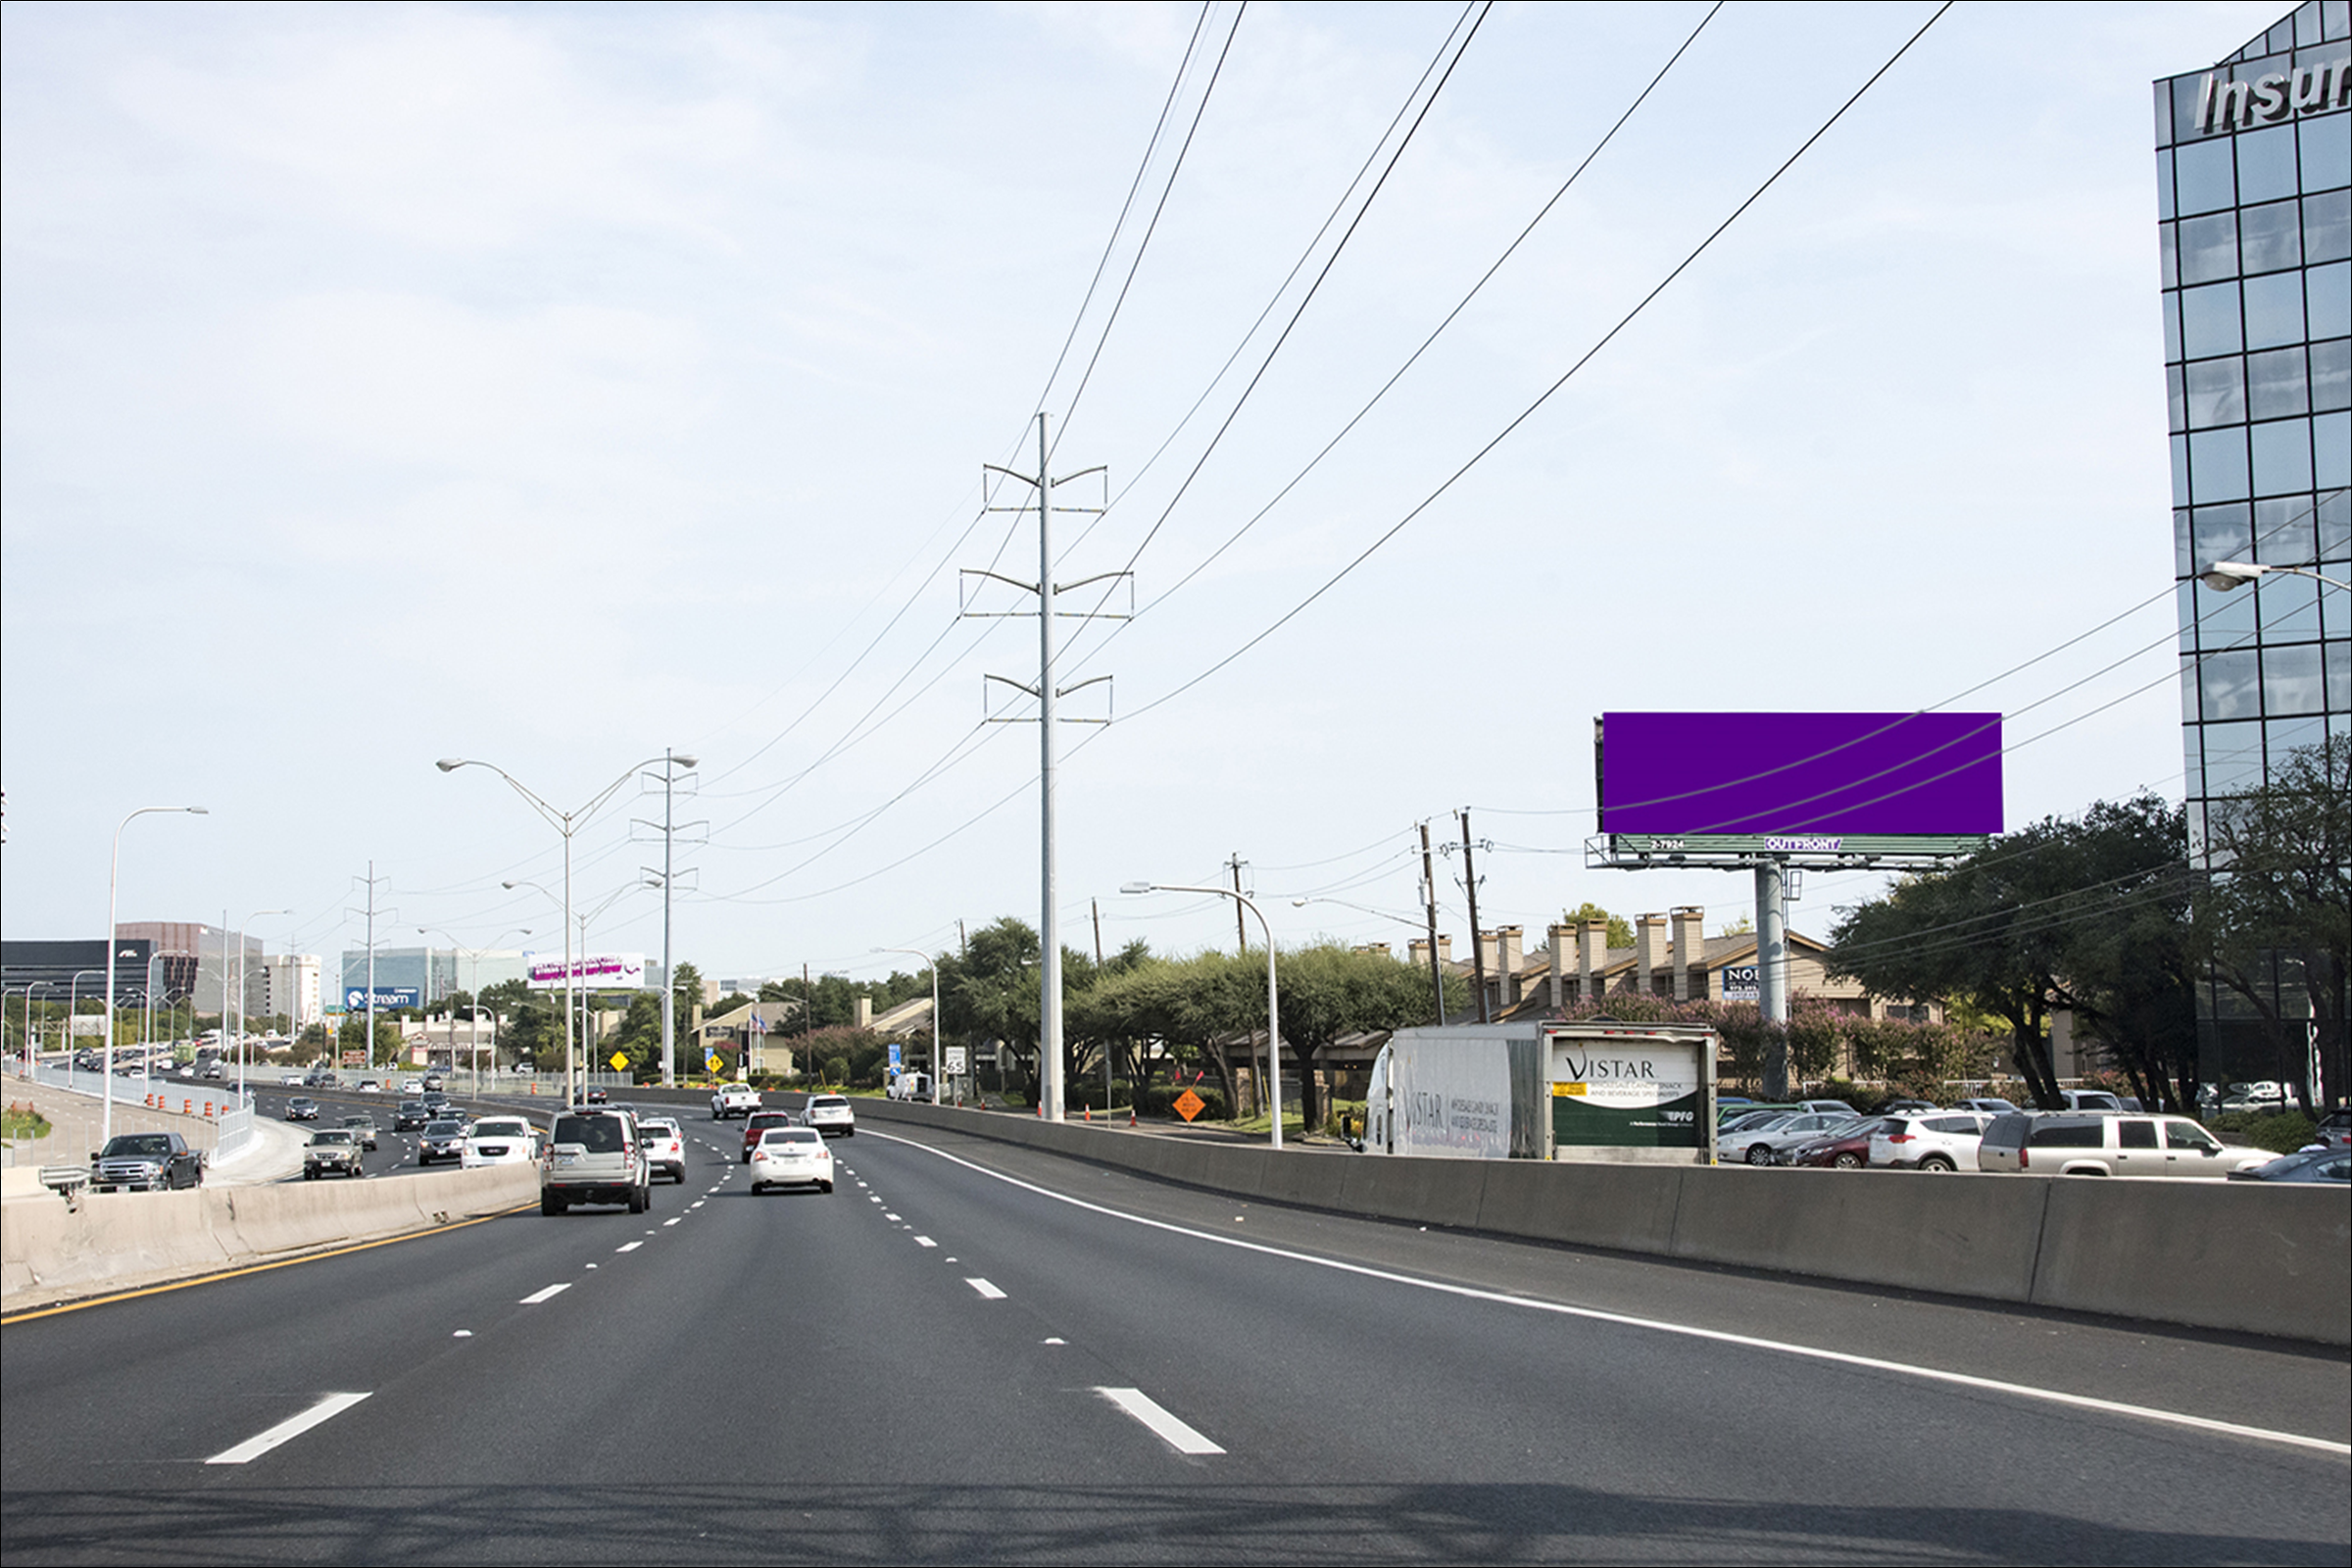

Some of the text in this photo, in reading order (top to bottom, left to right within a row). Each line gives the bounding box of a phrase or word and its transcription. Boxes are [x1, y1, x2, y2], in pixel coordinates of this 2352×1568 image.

[2194, 56, 2351, 130] Insur
[1766, 837, 1838, 850] OUTFRONT
[947, 1061, 964, 1072] 65
[1565, 1048, 1655, 1081] VISTAR
